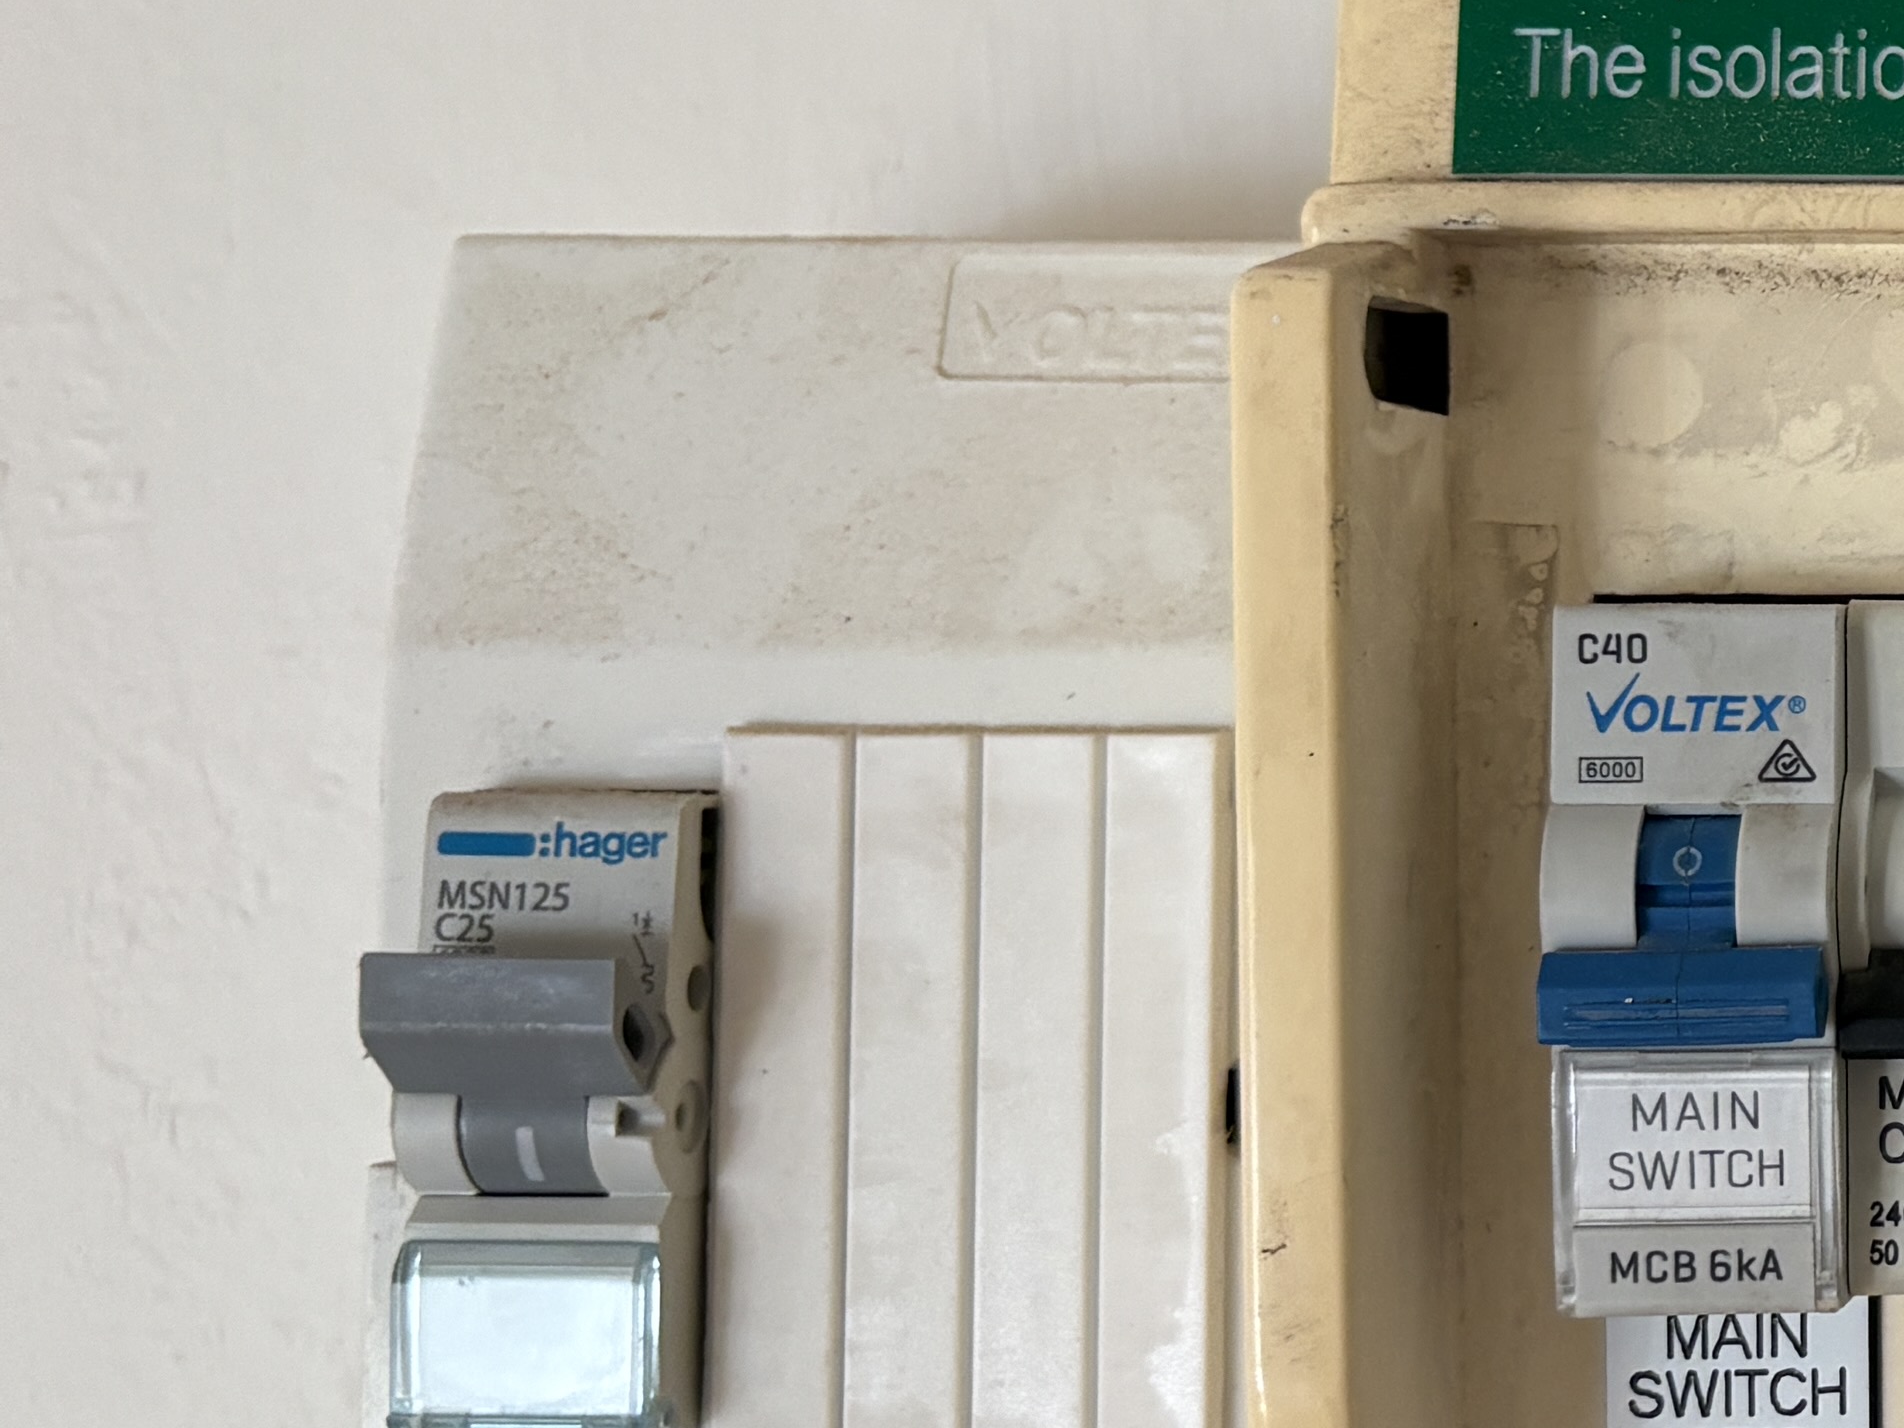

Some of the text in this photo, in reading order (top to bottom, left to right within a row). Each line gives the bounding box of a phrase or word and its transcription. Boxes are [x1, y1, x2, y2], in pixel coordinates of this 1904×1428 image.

[1517, 28, 1649, 97] The
[1577, 633, 1648, 664] C40
[1586, 761, 1636, 779] 6000
[438, 879, 570, 911] MSN125
[435, 913, 495, 943] C25
[1629, 1090, 1760, 1131] MAIN
[1608, 1149, 1786, 1191] SWITCH
[1609, 1250, 1783, 1283] MCB 6kA
[1665, 1313, 1809, 1360] MAIN
[1628, 1367, 1847, 1420] SWITCH
